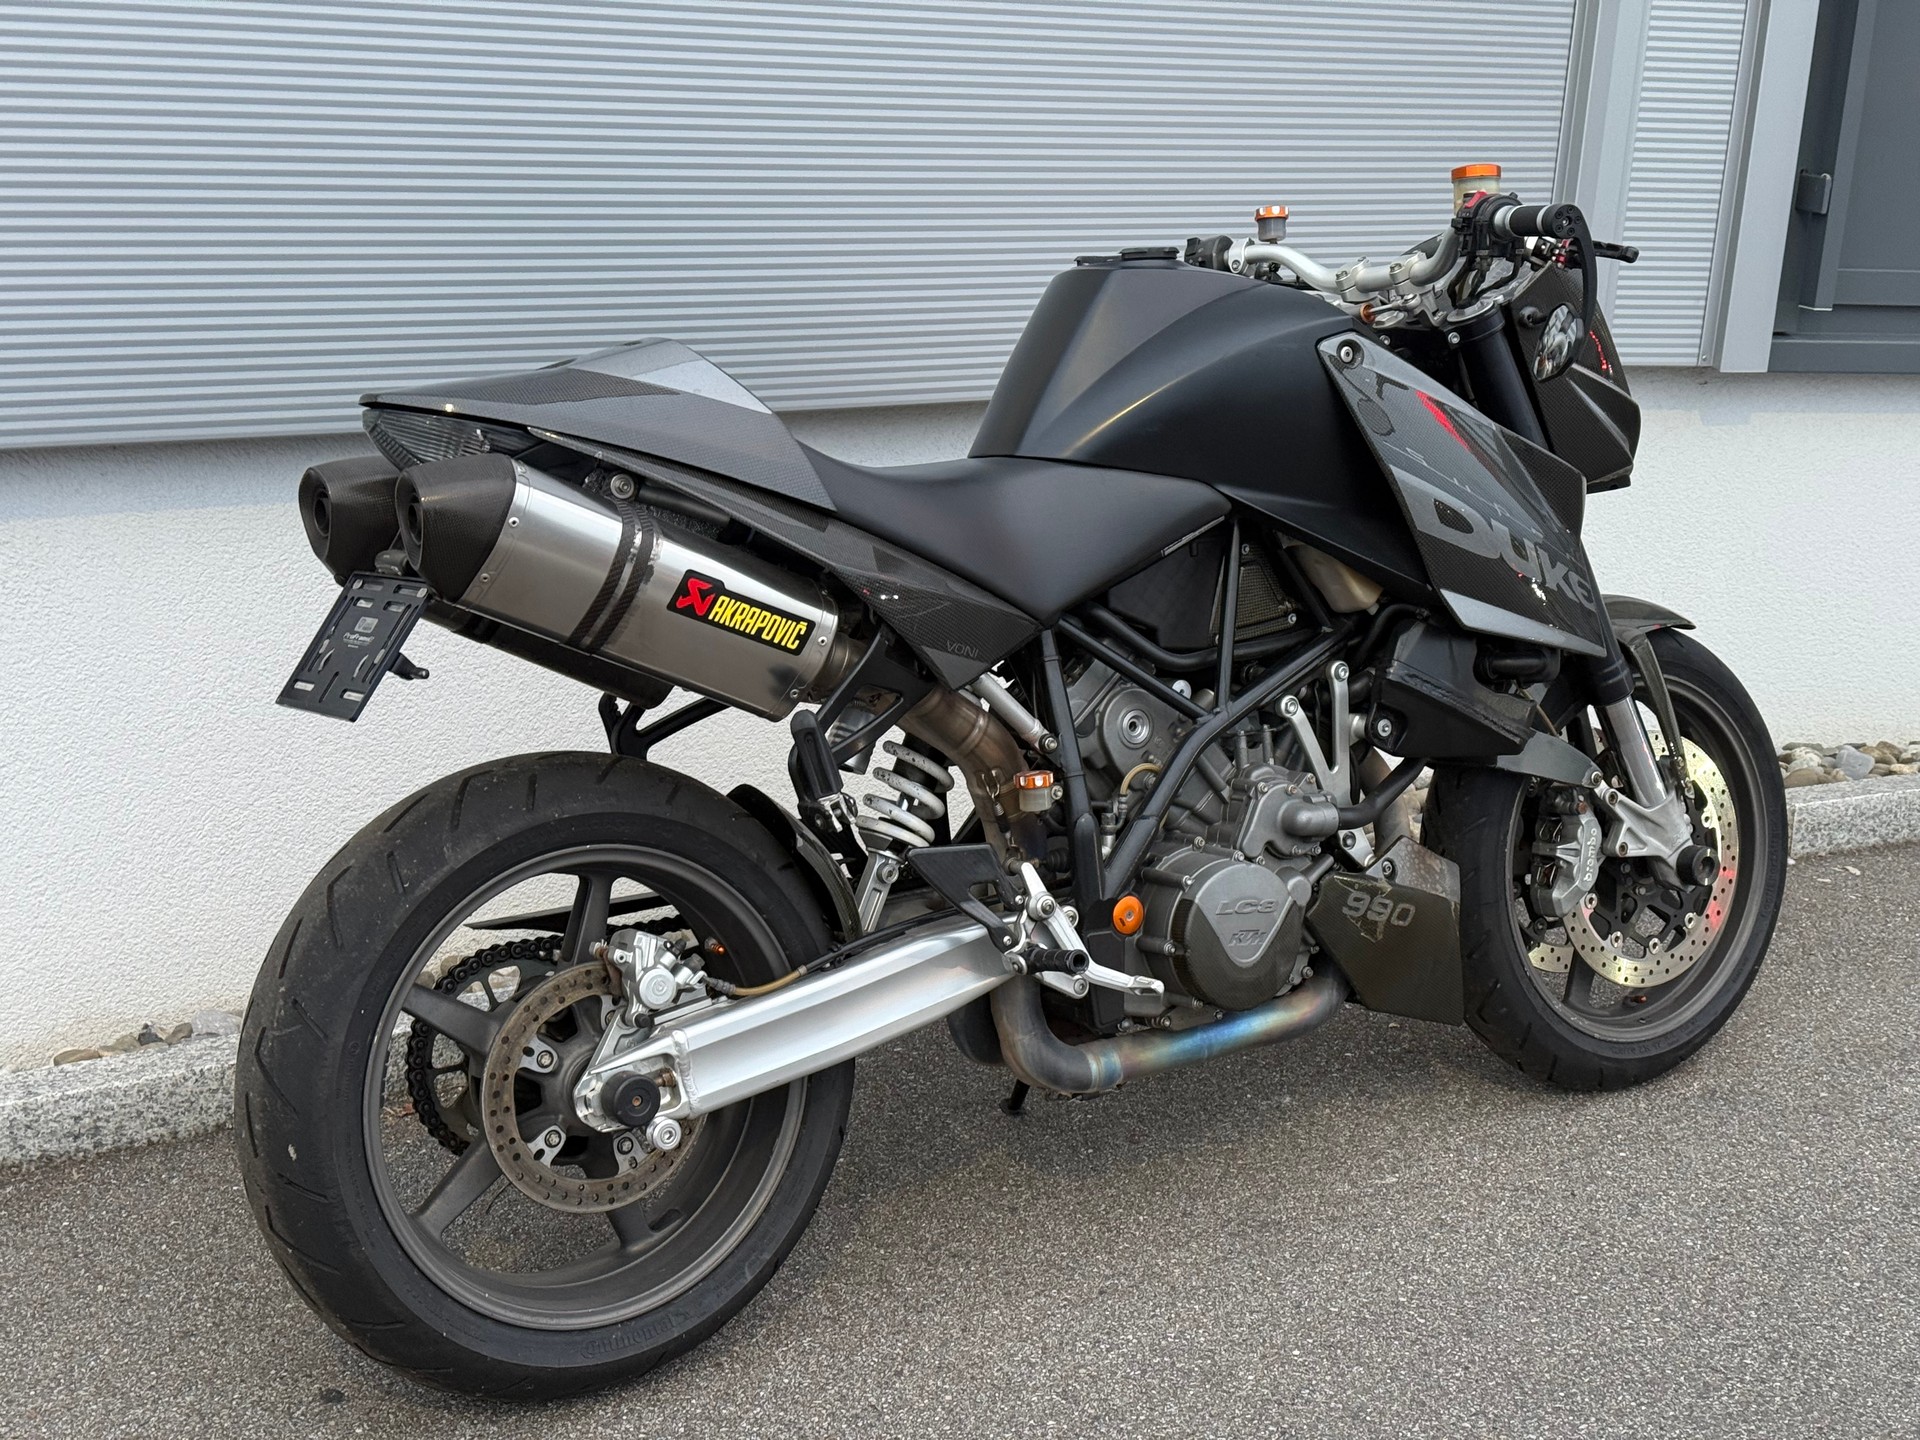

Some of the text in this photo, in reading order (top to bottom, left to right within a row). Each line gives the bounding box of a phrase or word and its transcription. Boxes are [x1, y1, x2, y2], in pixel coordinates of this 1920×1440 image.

[1389, 464, 1598, 613] DUKE
[946, 640, 979, 658] VONI
[1583, 828, 1598, 882] brembo
[1215, 899, 1278, 916] LC8
[1342, 890, 1416, 927] 990
[1228, 929, 1269, 946] KTM
